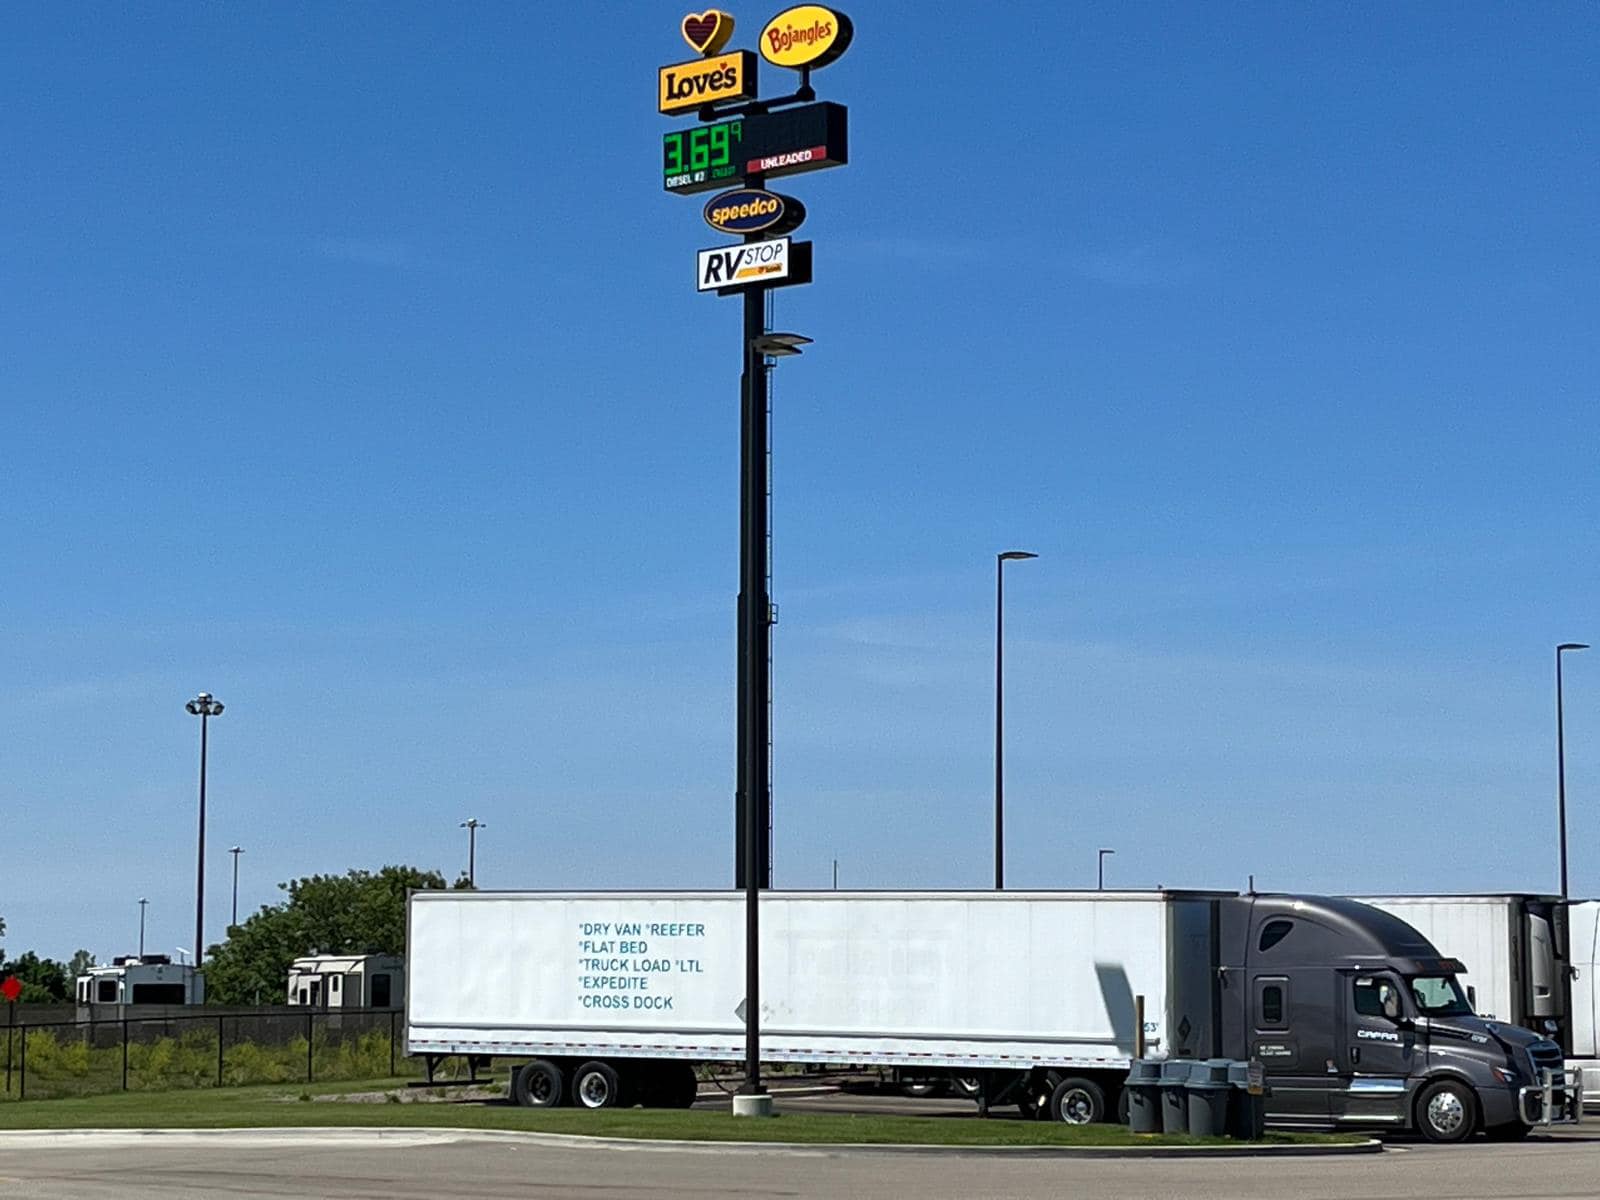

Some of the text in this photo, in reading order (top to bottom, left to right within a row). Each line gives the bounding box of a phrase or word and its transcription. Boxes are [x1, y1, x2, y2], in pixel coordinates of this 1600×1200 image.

[767, 20, 832, 54] Bojangles
[760, 150, 813, 170] UNLEADED
[666, 173, 692, 188] DIESEL
[711, 198, 778, 225] speedco
[704, 249, 746, 285] RV
[744, 243, 783, 265] STOP
[614, 923, 641, 936] VAN
[619, 941, 648, 954] BED
[633, 959, 671, 972] LOAD
[633, 995, 673, 1010] DOCK
